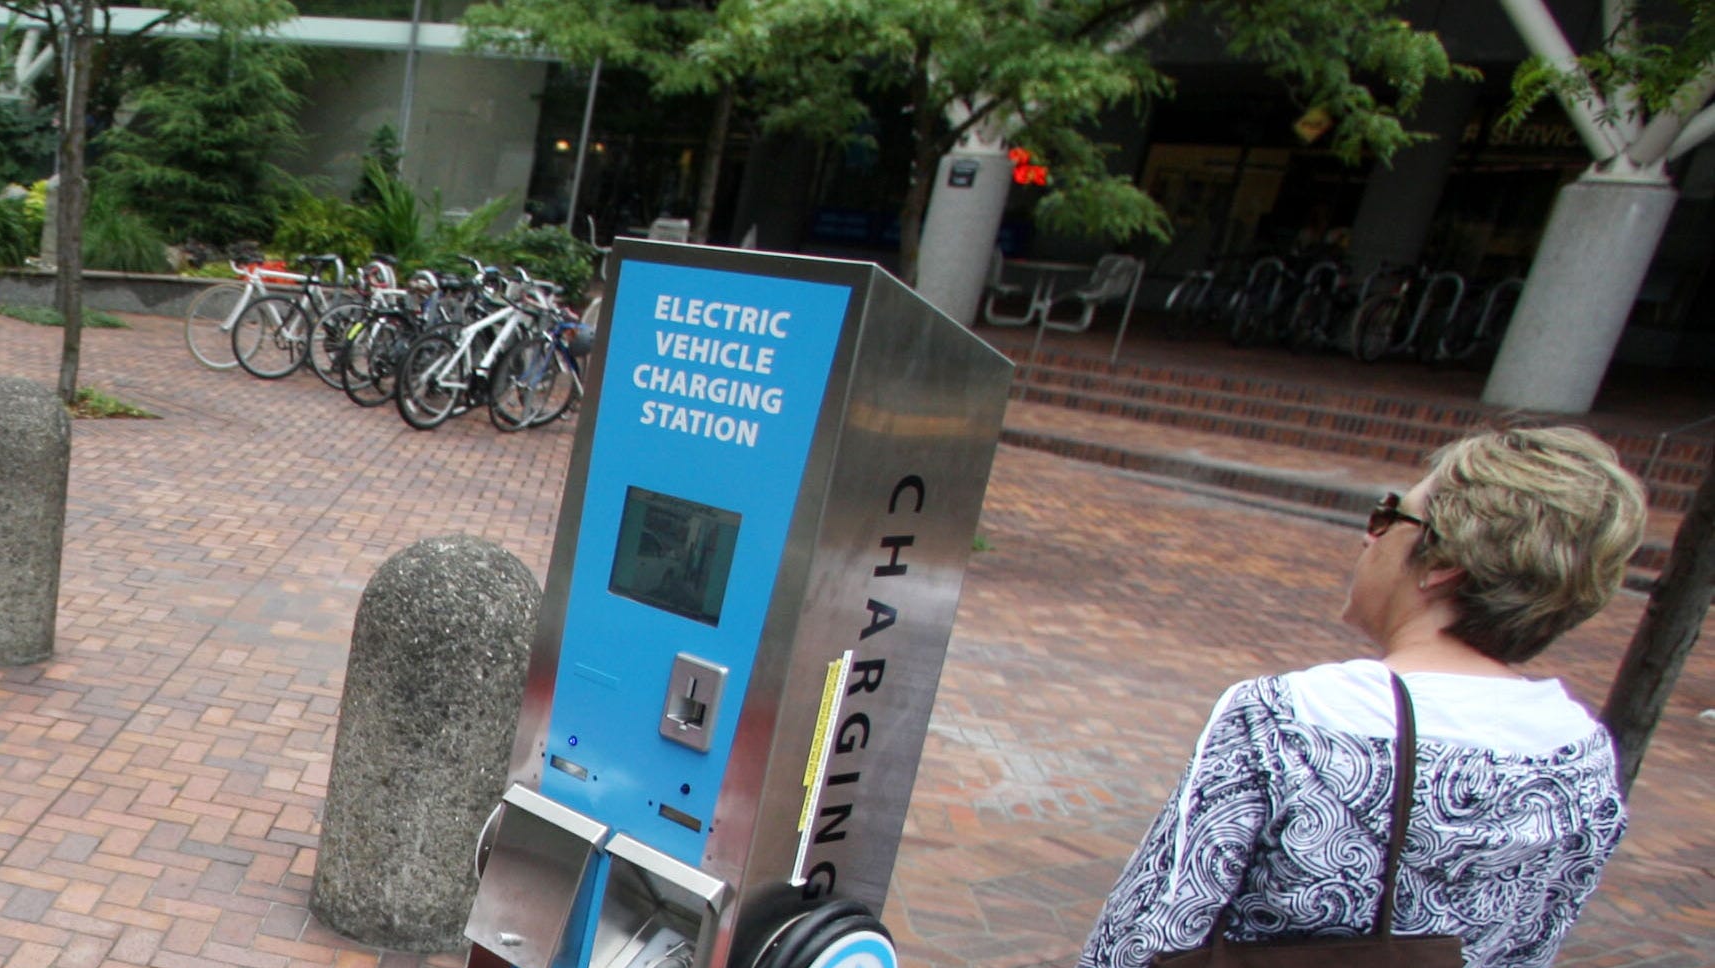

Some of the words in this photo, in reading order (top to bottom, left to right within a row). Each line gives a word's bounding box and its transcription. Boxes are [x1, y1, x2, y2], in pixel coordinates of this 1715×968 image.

[654, 294, 791, 339] ELECTRIC
[656, 331, 775, 375] VEHICLE
[632, 364, 784, 415] CHARGING
[639, 400, 760, 448] STATION
[802, 475, 926, 900] CHARGING
